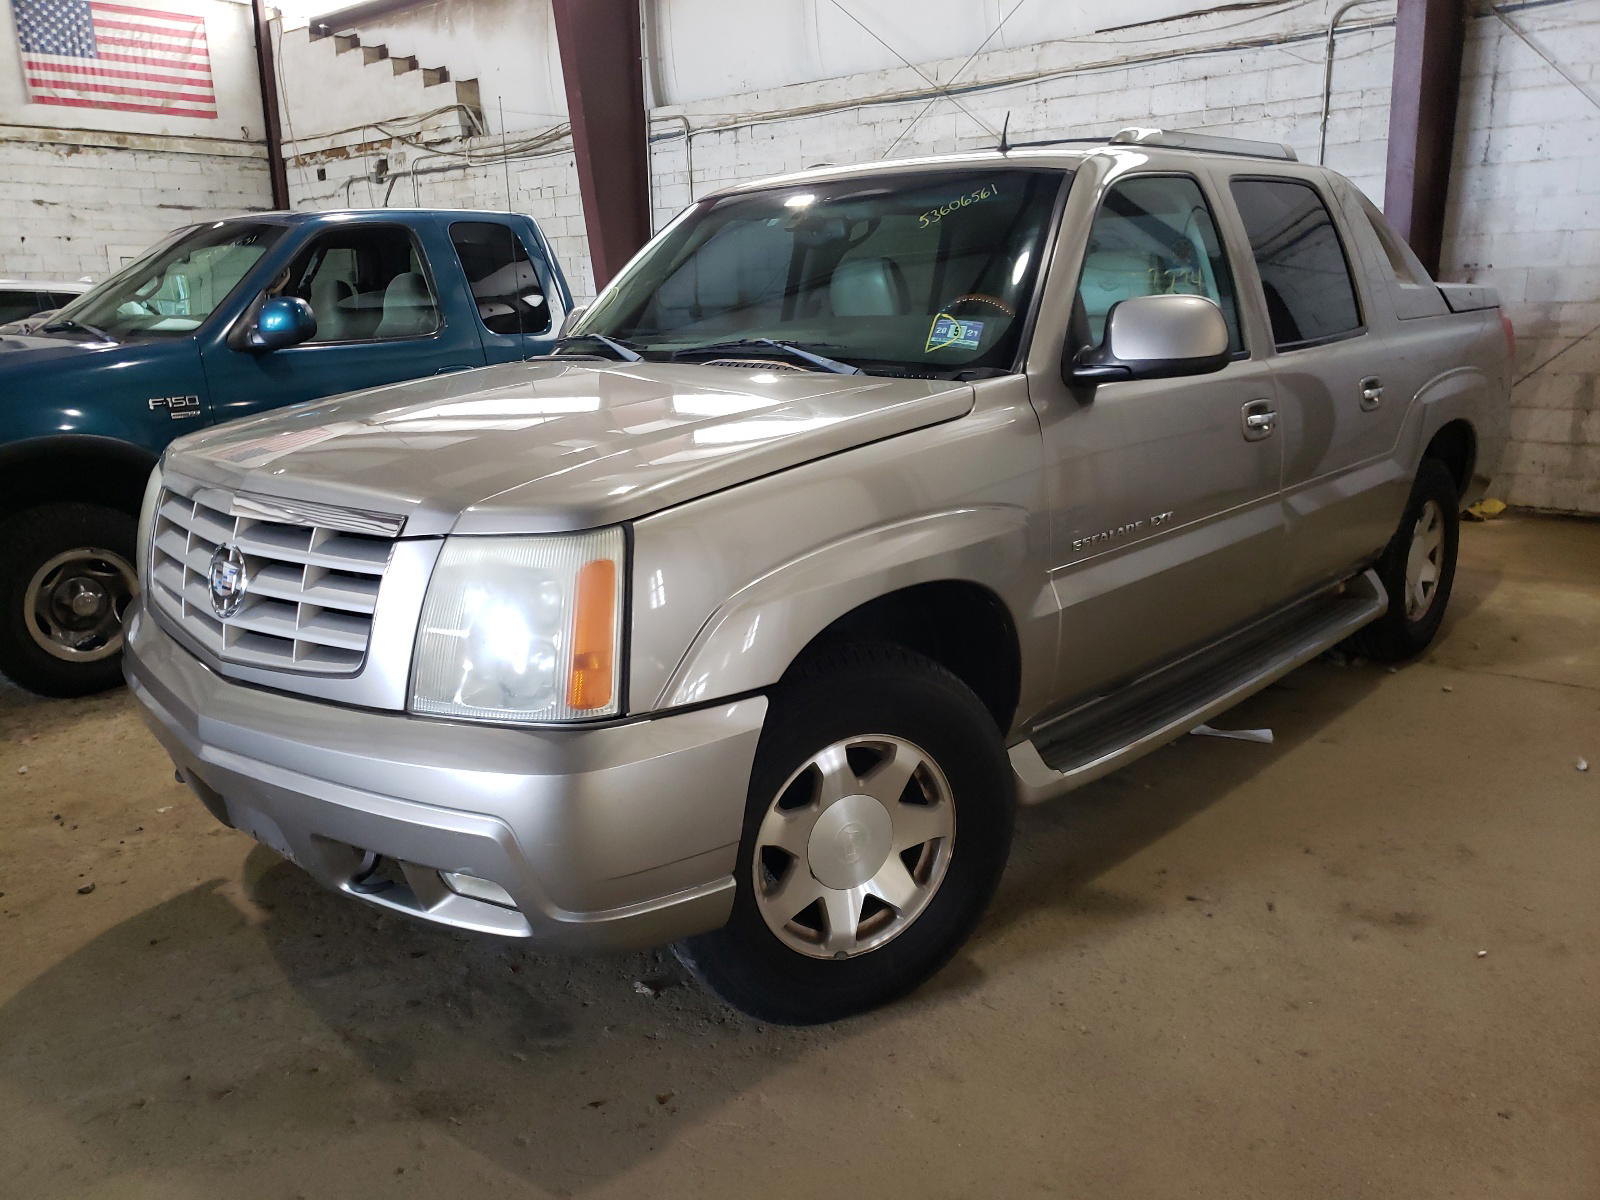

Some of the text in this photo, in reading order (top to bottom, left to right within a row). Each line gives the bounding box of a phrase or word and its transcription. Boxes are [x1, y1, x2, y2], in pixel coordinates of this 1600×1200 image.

[919, 183, 998, 229] 53606561
[953, 326, 961, 337] 5
[966, 329, 979, 337] 21
